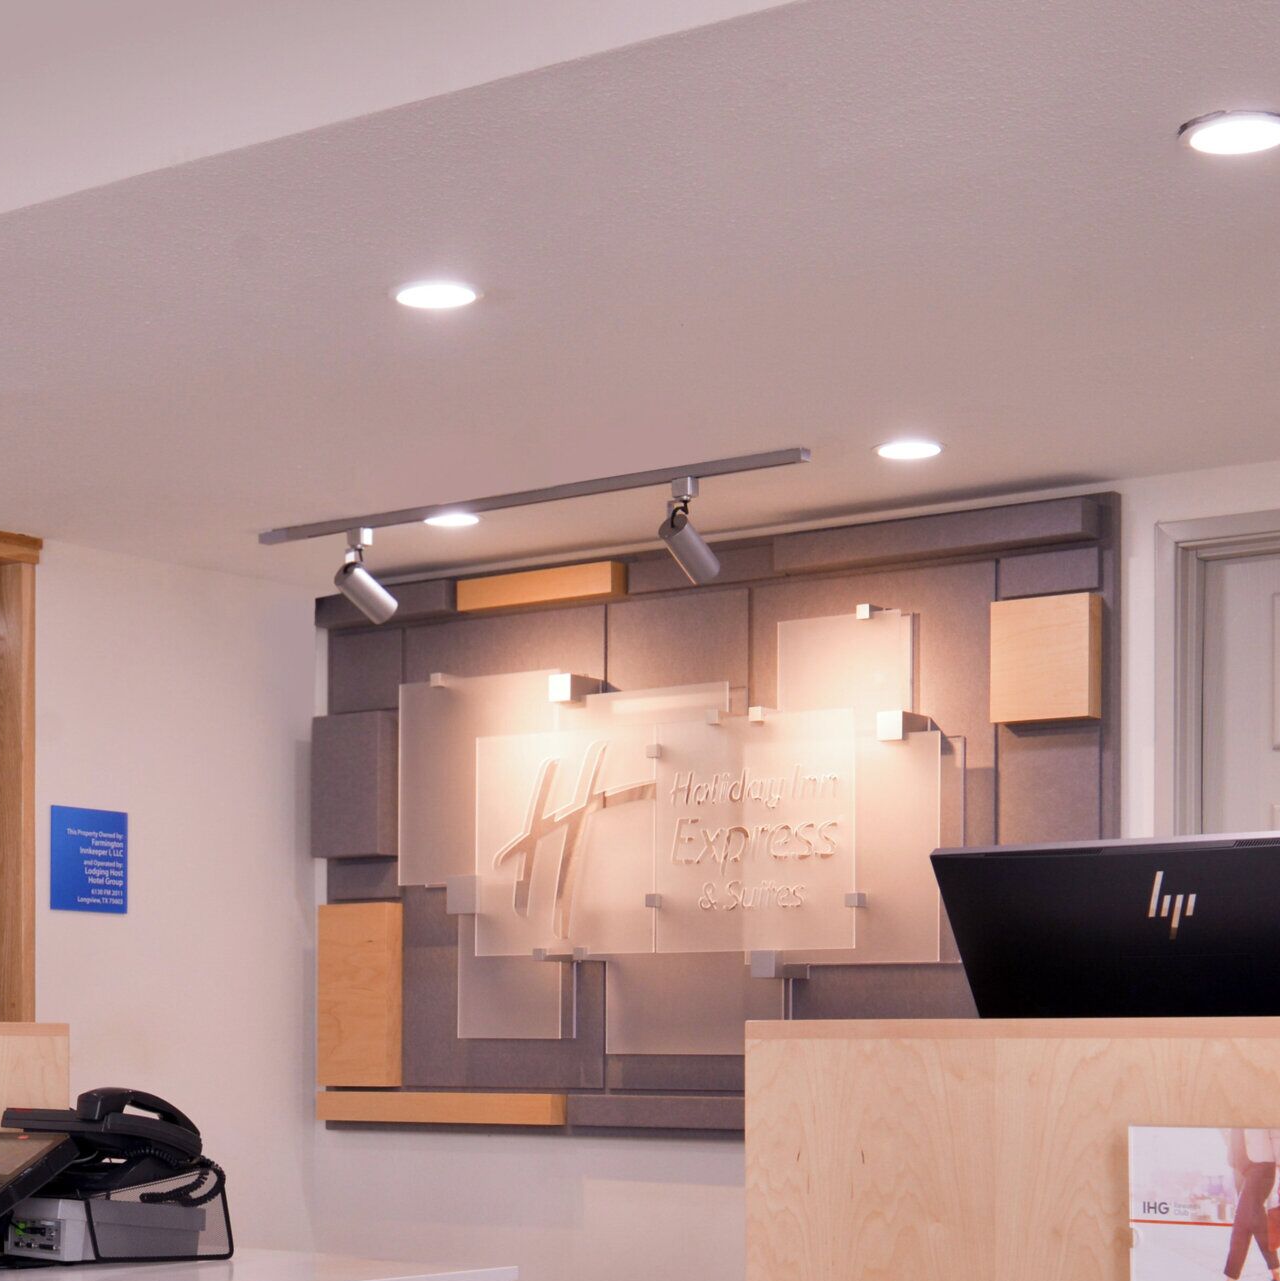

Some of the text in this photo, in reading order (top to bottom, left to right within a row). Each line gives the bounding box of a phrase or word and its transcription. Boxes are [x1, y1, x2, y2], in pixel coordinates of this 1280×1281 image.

[669, 766, 787, 809] Holiday
[91, 838, 123, 849] Farmington
[671, 816, 841, 876] Express
[80, 847, 107, 856] Innkeeper
[84, 867, 123, 877] Lodging Host
[88, 876, 123, 887] Hotel Group
[723, 879, 806, 911] Suites
[1143, 1201, 1169, 1215] IHG
